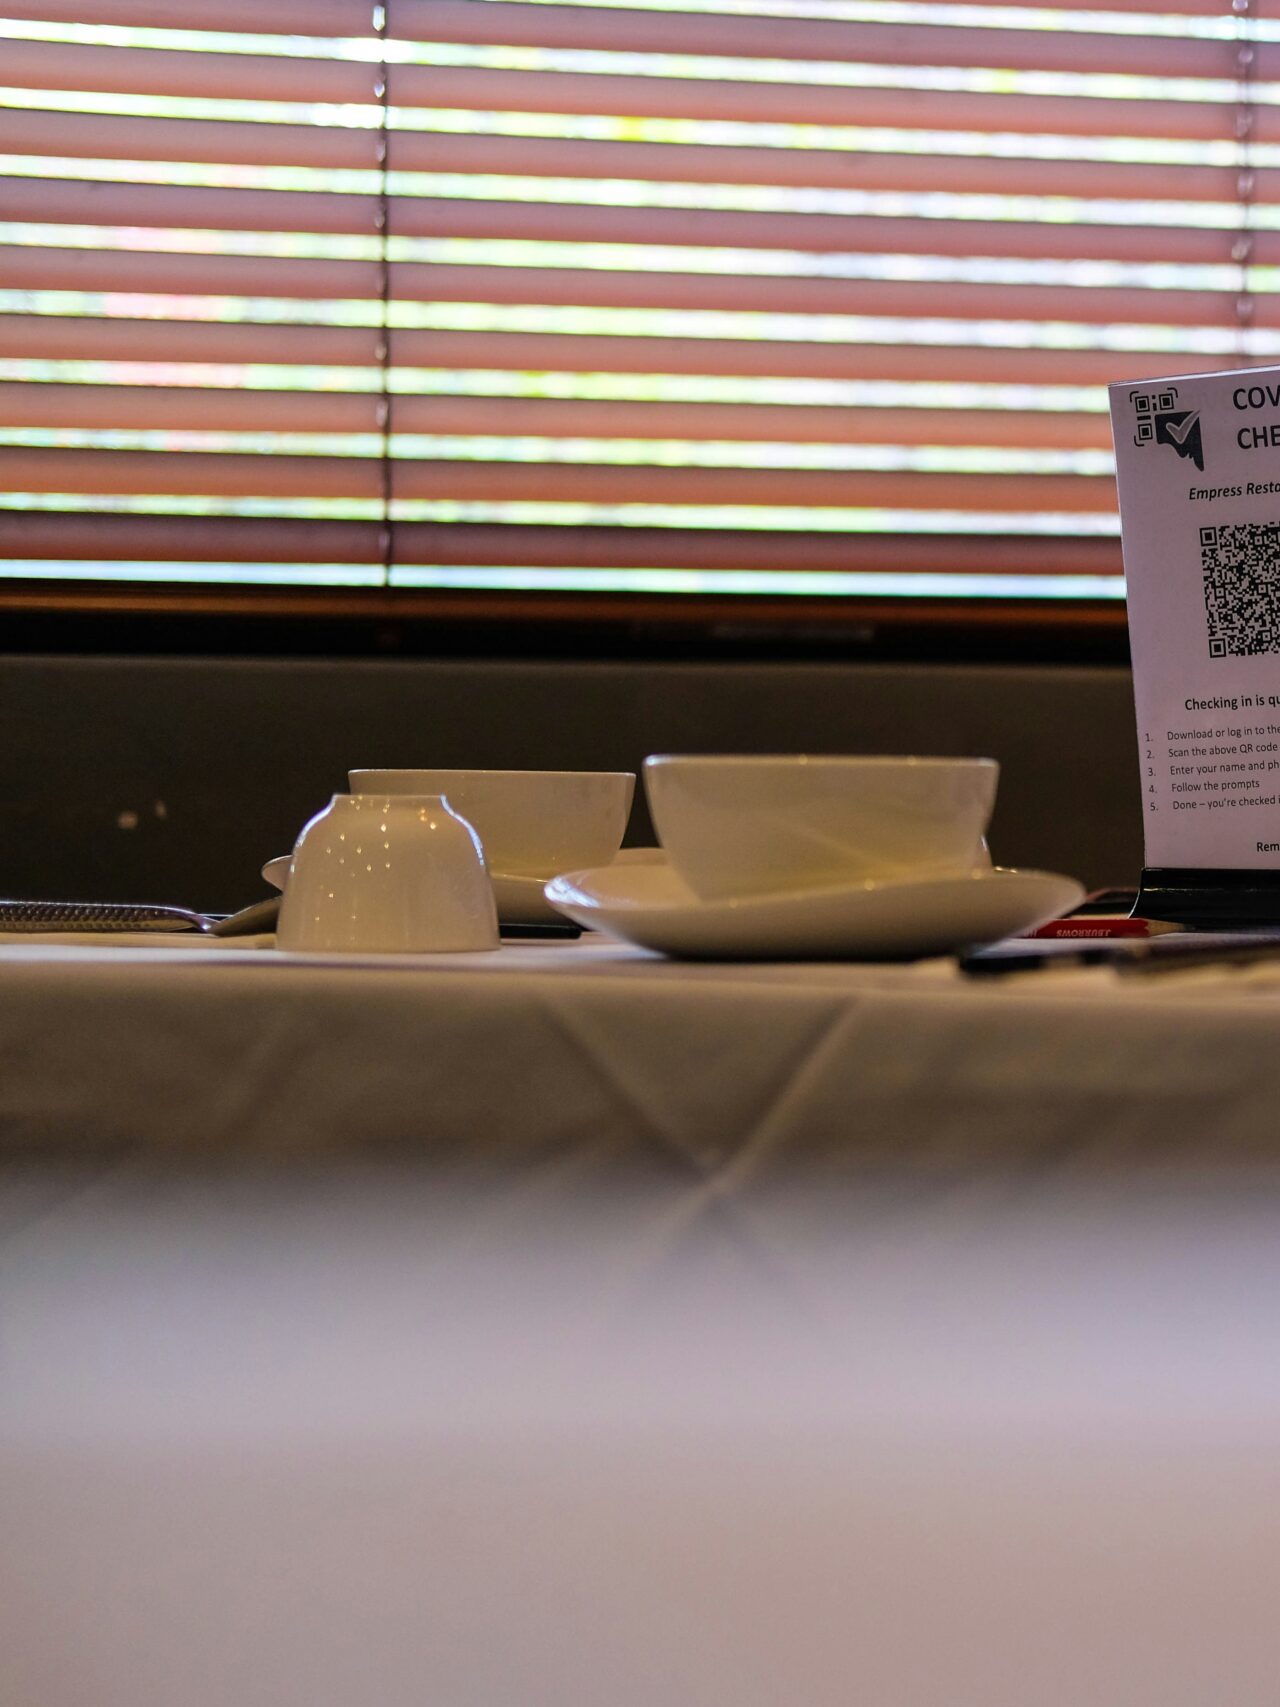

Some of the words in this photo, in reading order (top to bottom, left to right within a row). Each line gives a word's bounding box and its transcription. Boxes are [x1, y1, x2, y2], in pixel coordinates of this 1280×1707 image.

[1189, 486, 1242, 501] Empress
[1185, 697, 1238, 711] Checking
[1241, 695, 1252, 707] in
[1256, 694, 1265, 706] is
[1145, 733, 1154, 742] 1.
[1167, 728, 1213, 741] Download
[1215, 729, 1225, 738] or
[1227, 727, 1242, 738] log
[1244, 726, 1253, 736] in
[1255, 726, 1265, 735] to
[1146, 750, 1155, 759] 2.
[1168, 748, 1189, 758] Scan
[1191, 746, 1207, 756] the
[1209, 744, 1237, 755] above
[1239, 743, 1254, 754] QR
[1255, 742, 1278, 752] code
[1148, 767, 1157, 777] 3.
[1170, 766, 1194, 776] Enter
[1196, 764, 1217, 775] your
[1219, 763, 1246, 773] name
[1248, 761, 1265, 771] and
[1148, 785, 1158, 794] 4.
[1171, 782, 1201, 793] Follow
[1203, 781, 1219, 791] the
[1221, 779, 1260, 792] prompts
[1150, 802, 1159, 812] 5.
[1173, 800, 1197, 810] Done
[1207, 797, 1237, 810] you’re
[1238, 795, 1276, 807] checked
